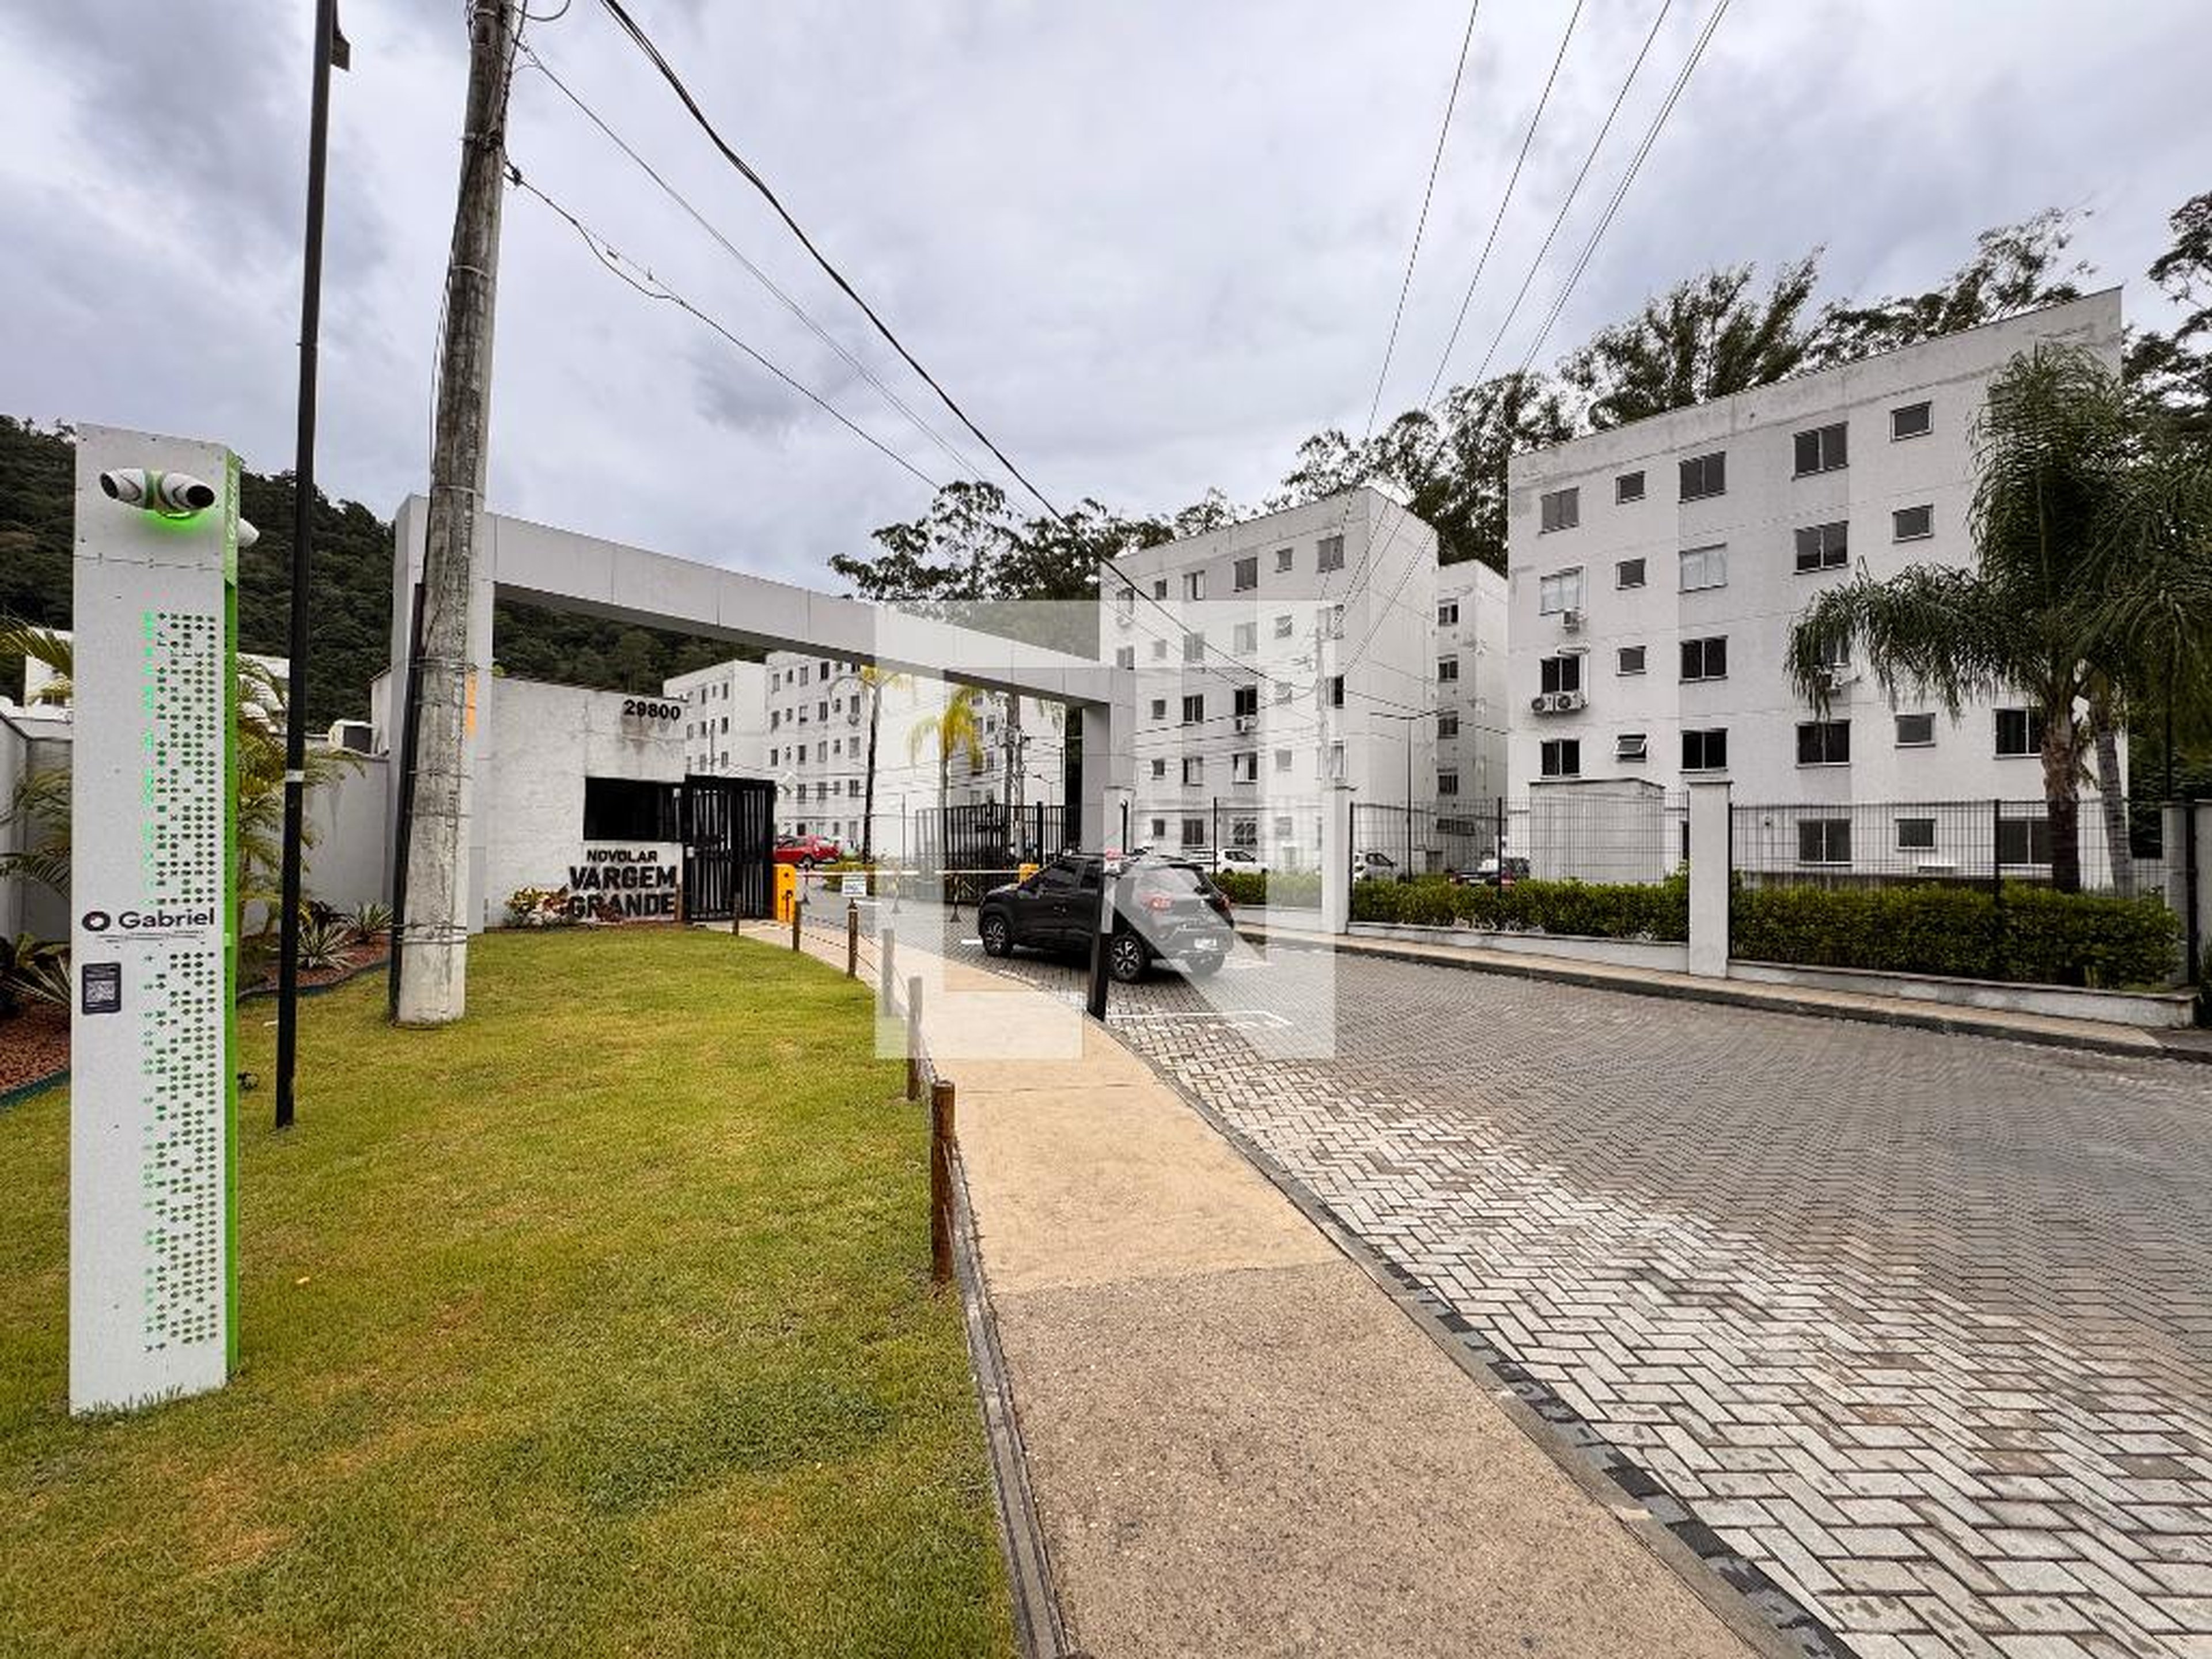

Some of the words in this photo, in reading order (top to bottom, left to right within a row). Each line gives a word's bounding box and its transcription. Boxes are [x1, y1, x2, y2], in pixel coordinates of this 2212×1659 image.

[587, 850, 657, 862] NOVOLAR
[570, 866, 676, 890] VARGEM
[569, 893, 675, 919] GRANDE
[119, 907, 214, 929] Gabriel
